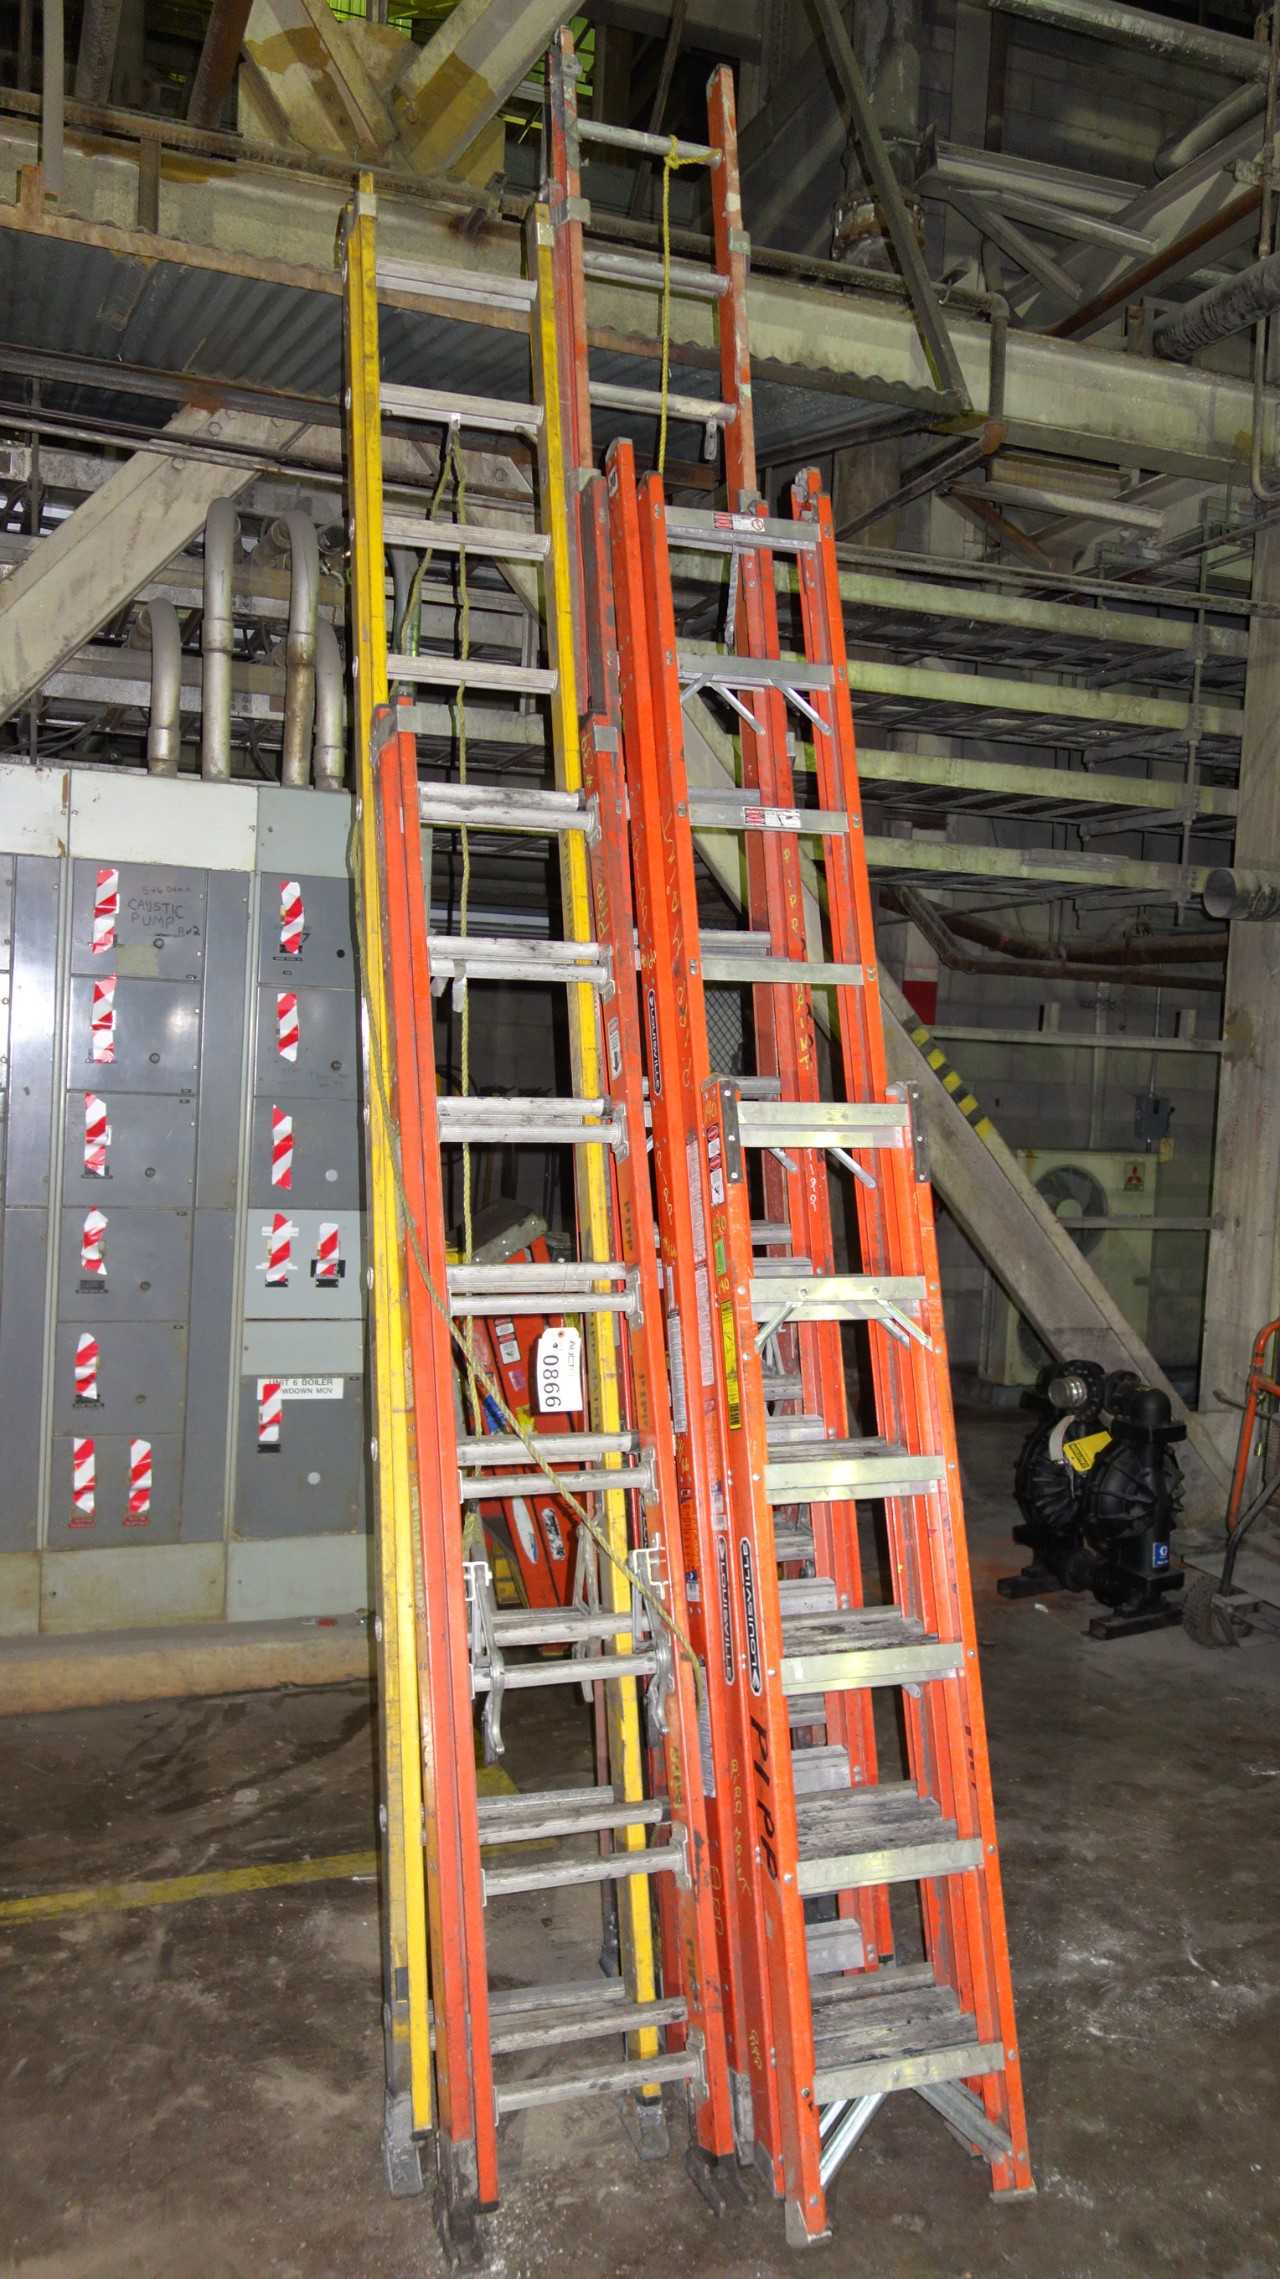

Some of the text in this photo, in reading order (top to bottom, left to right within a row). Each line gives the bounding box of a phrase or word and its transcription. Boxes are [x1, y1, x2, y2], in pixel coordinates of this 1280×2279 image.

[128, 898, 185, 919] CAUSTIC
[131, 911, 174, 929] PUMP
[301, 1377, 333, 1386] BOILER
[543, 1355, 561, 1407] 0866
[742, 1543, 757, 1667] LOUISVILLE
